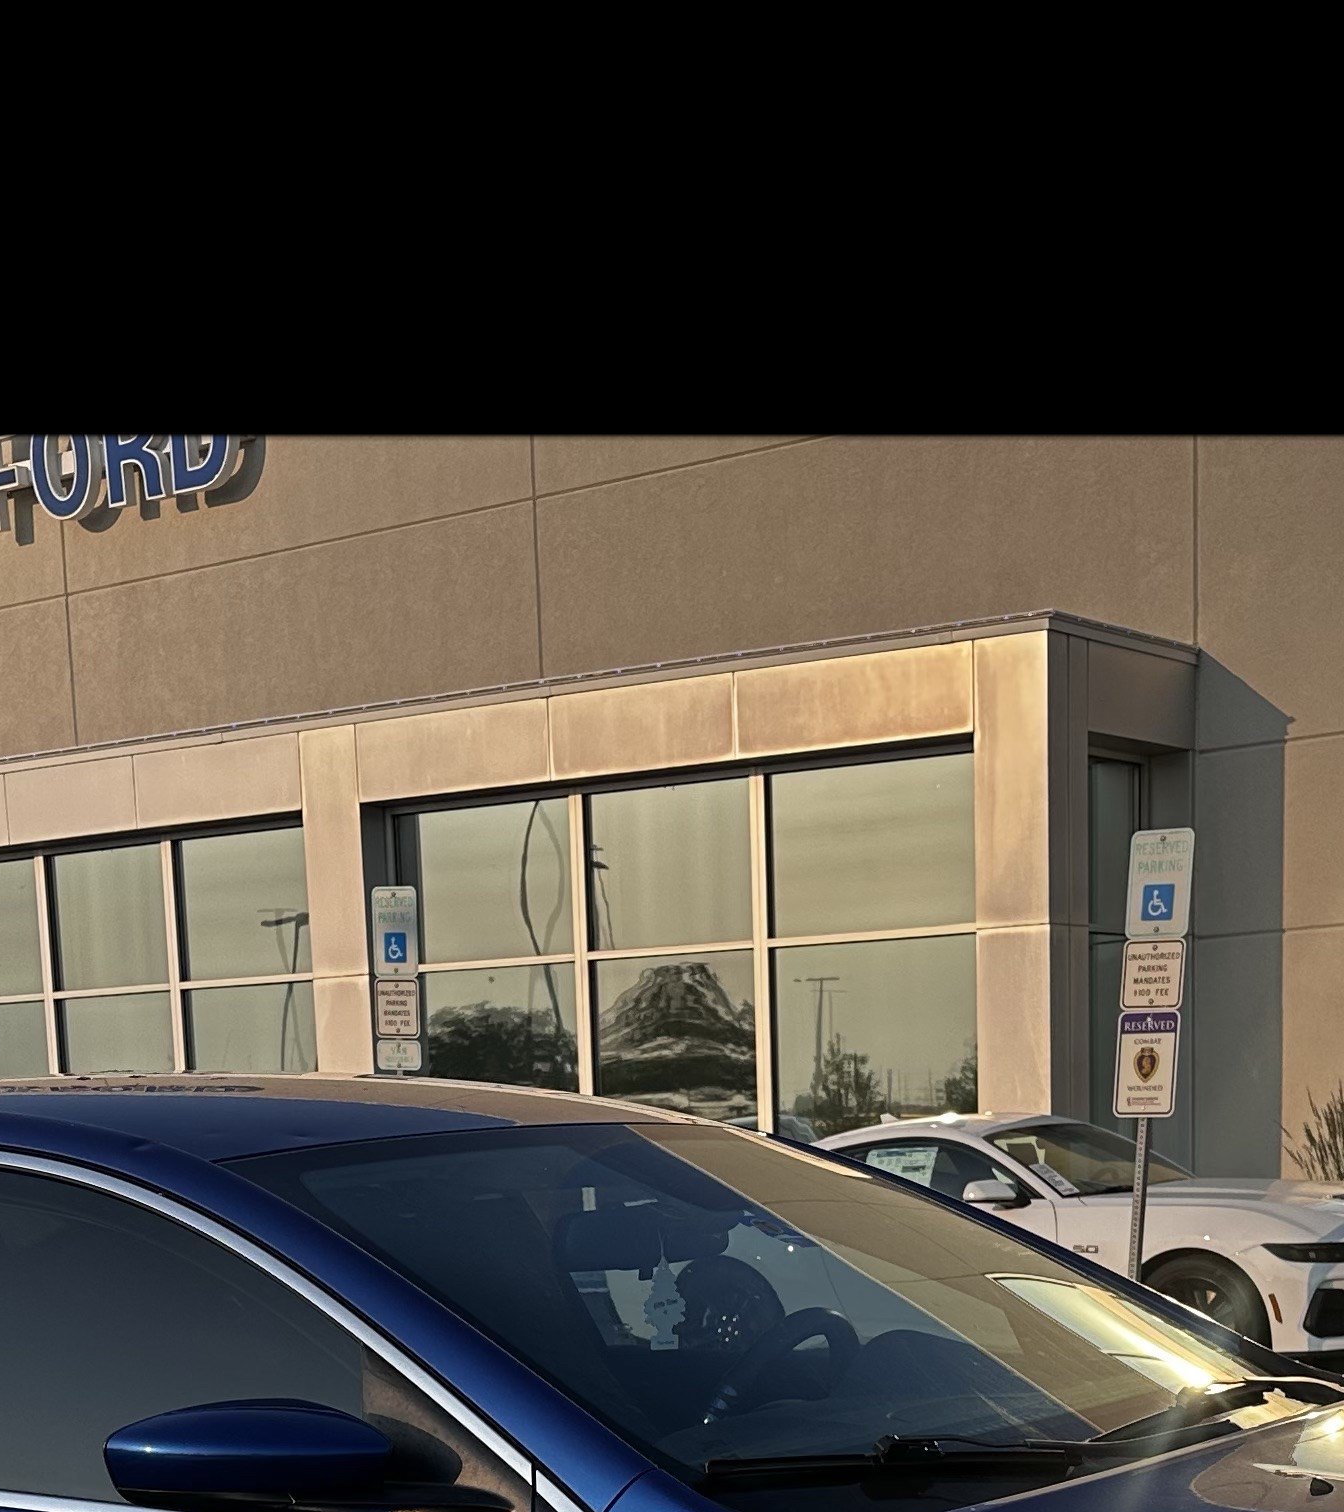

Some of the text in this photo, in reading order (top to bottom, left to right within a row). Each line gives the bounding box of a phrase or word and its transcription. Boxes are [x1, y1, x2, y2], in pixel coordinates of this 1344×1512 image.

[1135, 841, 1189, 855] RESERVED
[1137, 860, 1184, 873] PARKING
[1127, 952, 1181, 961] UNAUTHORIZED
[1137, 964, 1168, 972] PARKING
[1133, 976, 1171, 984] MANDATES
[1123, 1020, 1175, 1032] RESERVED
